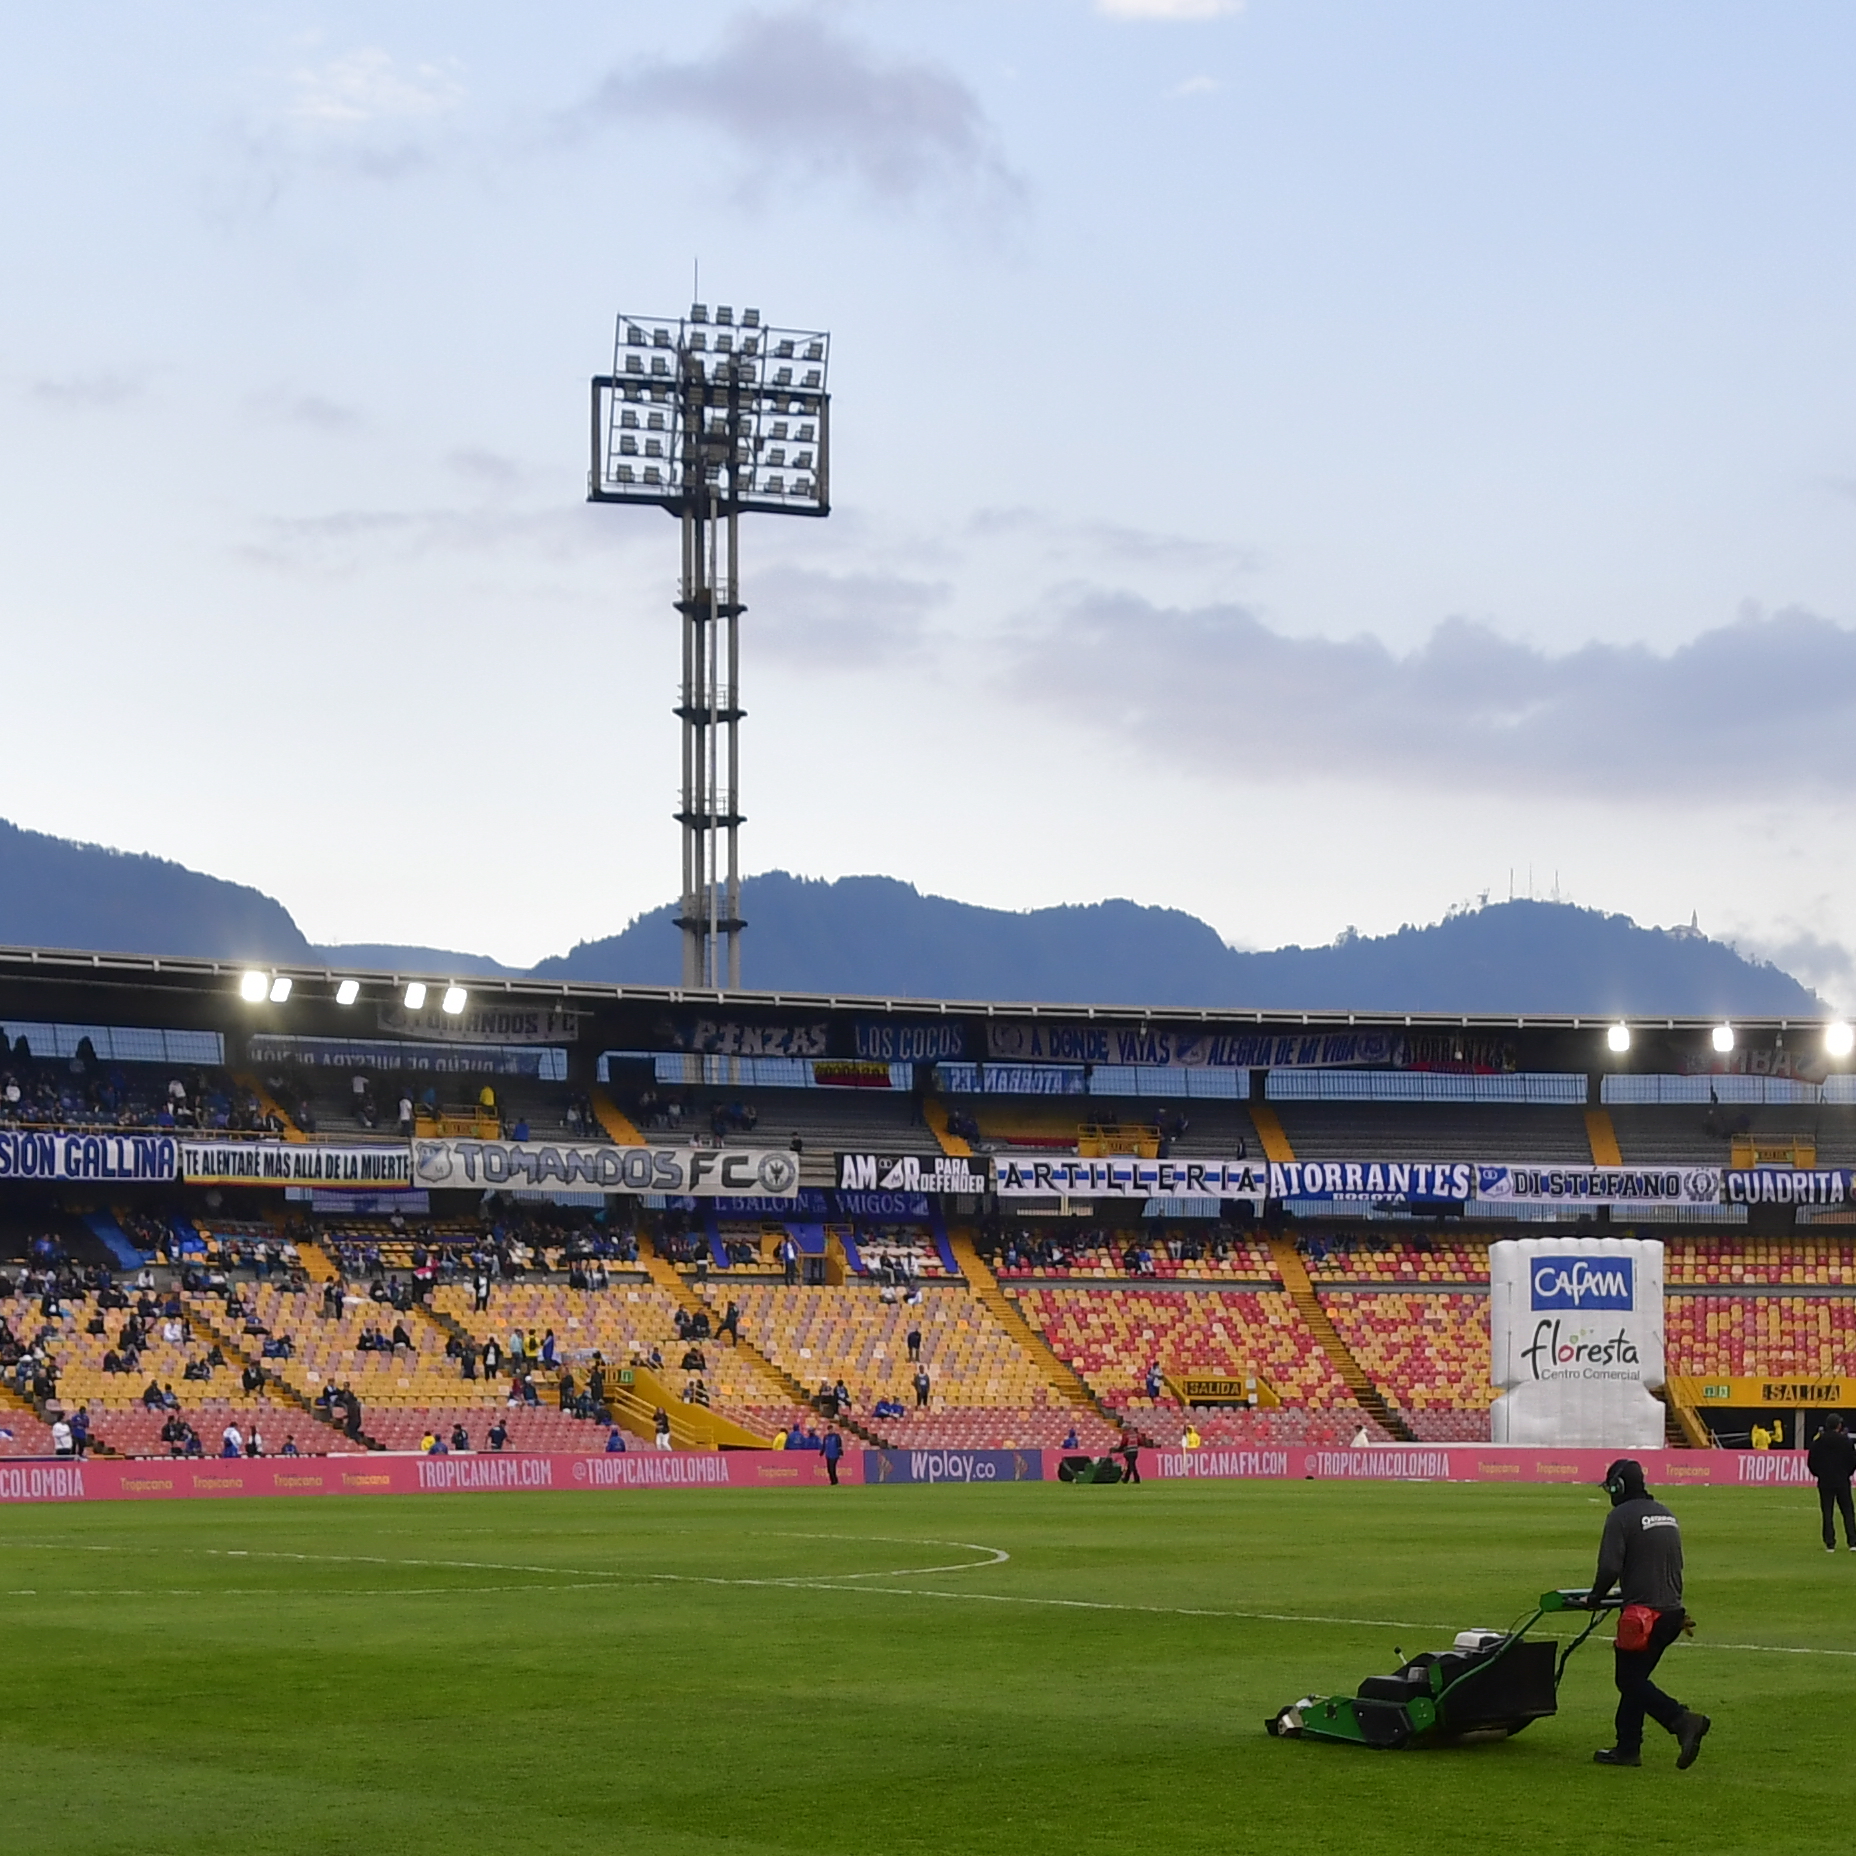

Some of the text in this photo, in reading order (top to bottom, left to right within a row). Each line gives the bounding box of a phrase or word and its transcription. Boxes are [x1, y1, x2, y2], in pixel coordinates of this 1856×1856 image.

[694, 1020, 828, 1055] PINZAS
[855, 1023, 962, 1059] LOS COCOS
[1117, 1029, 1171, 1064] VAYAS
[64, 1136, 176, 1179] GALLINA
[185, 1146, 409, 1180] TE ALENTARÉ MÁS ALLÁ DE LA MUERTE
[455, 1143, 759, 1192] TOMANDOS FC
[934, 1158, 969, 1175] PARA
[920, 1173, 985, 1193] DEFENDER
[1003, 1162, 1257, 1192] ARTILLERIA
[1269, 1162, 1471, 1198] ATORRANTES
[1512, 1171, 1542, 1198] DI
[1728, 1170, 1844, 1204] CUADRITA
[1521, 1319, 1639, 1380] floresta
[1541, 1368, 1640, 1381] Centro Comercial
[1190, 1381, 1241, 1395] SALIDA
[1769, 1384, 1840, 1401] SALIDA
[417, 1460, 552, 1488] TROPICANAFM.COM
[572, 1457, 729, 1484] @TROPICANACOLOMBIA
[757, 1465, 798, 1479] Tropicana
[911, 1451, 995, 1483] Wplay.co
[1157, 1451, 1287, 1477] TROPICANAFM.COM
[1305, 1451, 1449, 1477] @TROPICANACOLOMBIA
[1478, 1462, 1520, 1474] Tropicana
[1537, 1462, 1578, 1475] Tropicana
[1666, 1464, 1710, 1477] Tropicana
[120, 1477, 173, 1492] Tropicana
[193, 1475, 243, 1490] Tropicana
[274, 1473, 323, 1488] Tropicana
[342, 1472, 390, 1486] Tropicana
